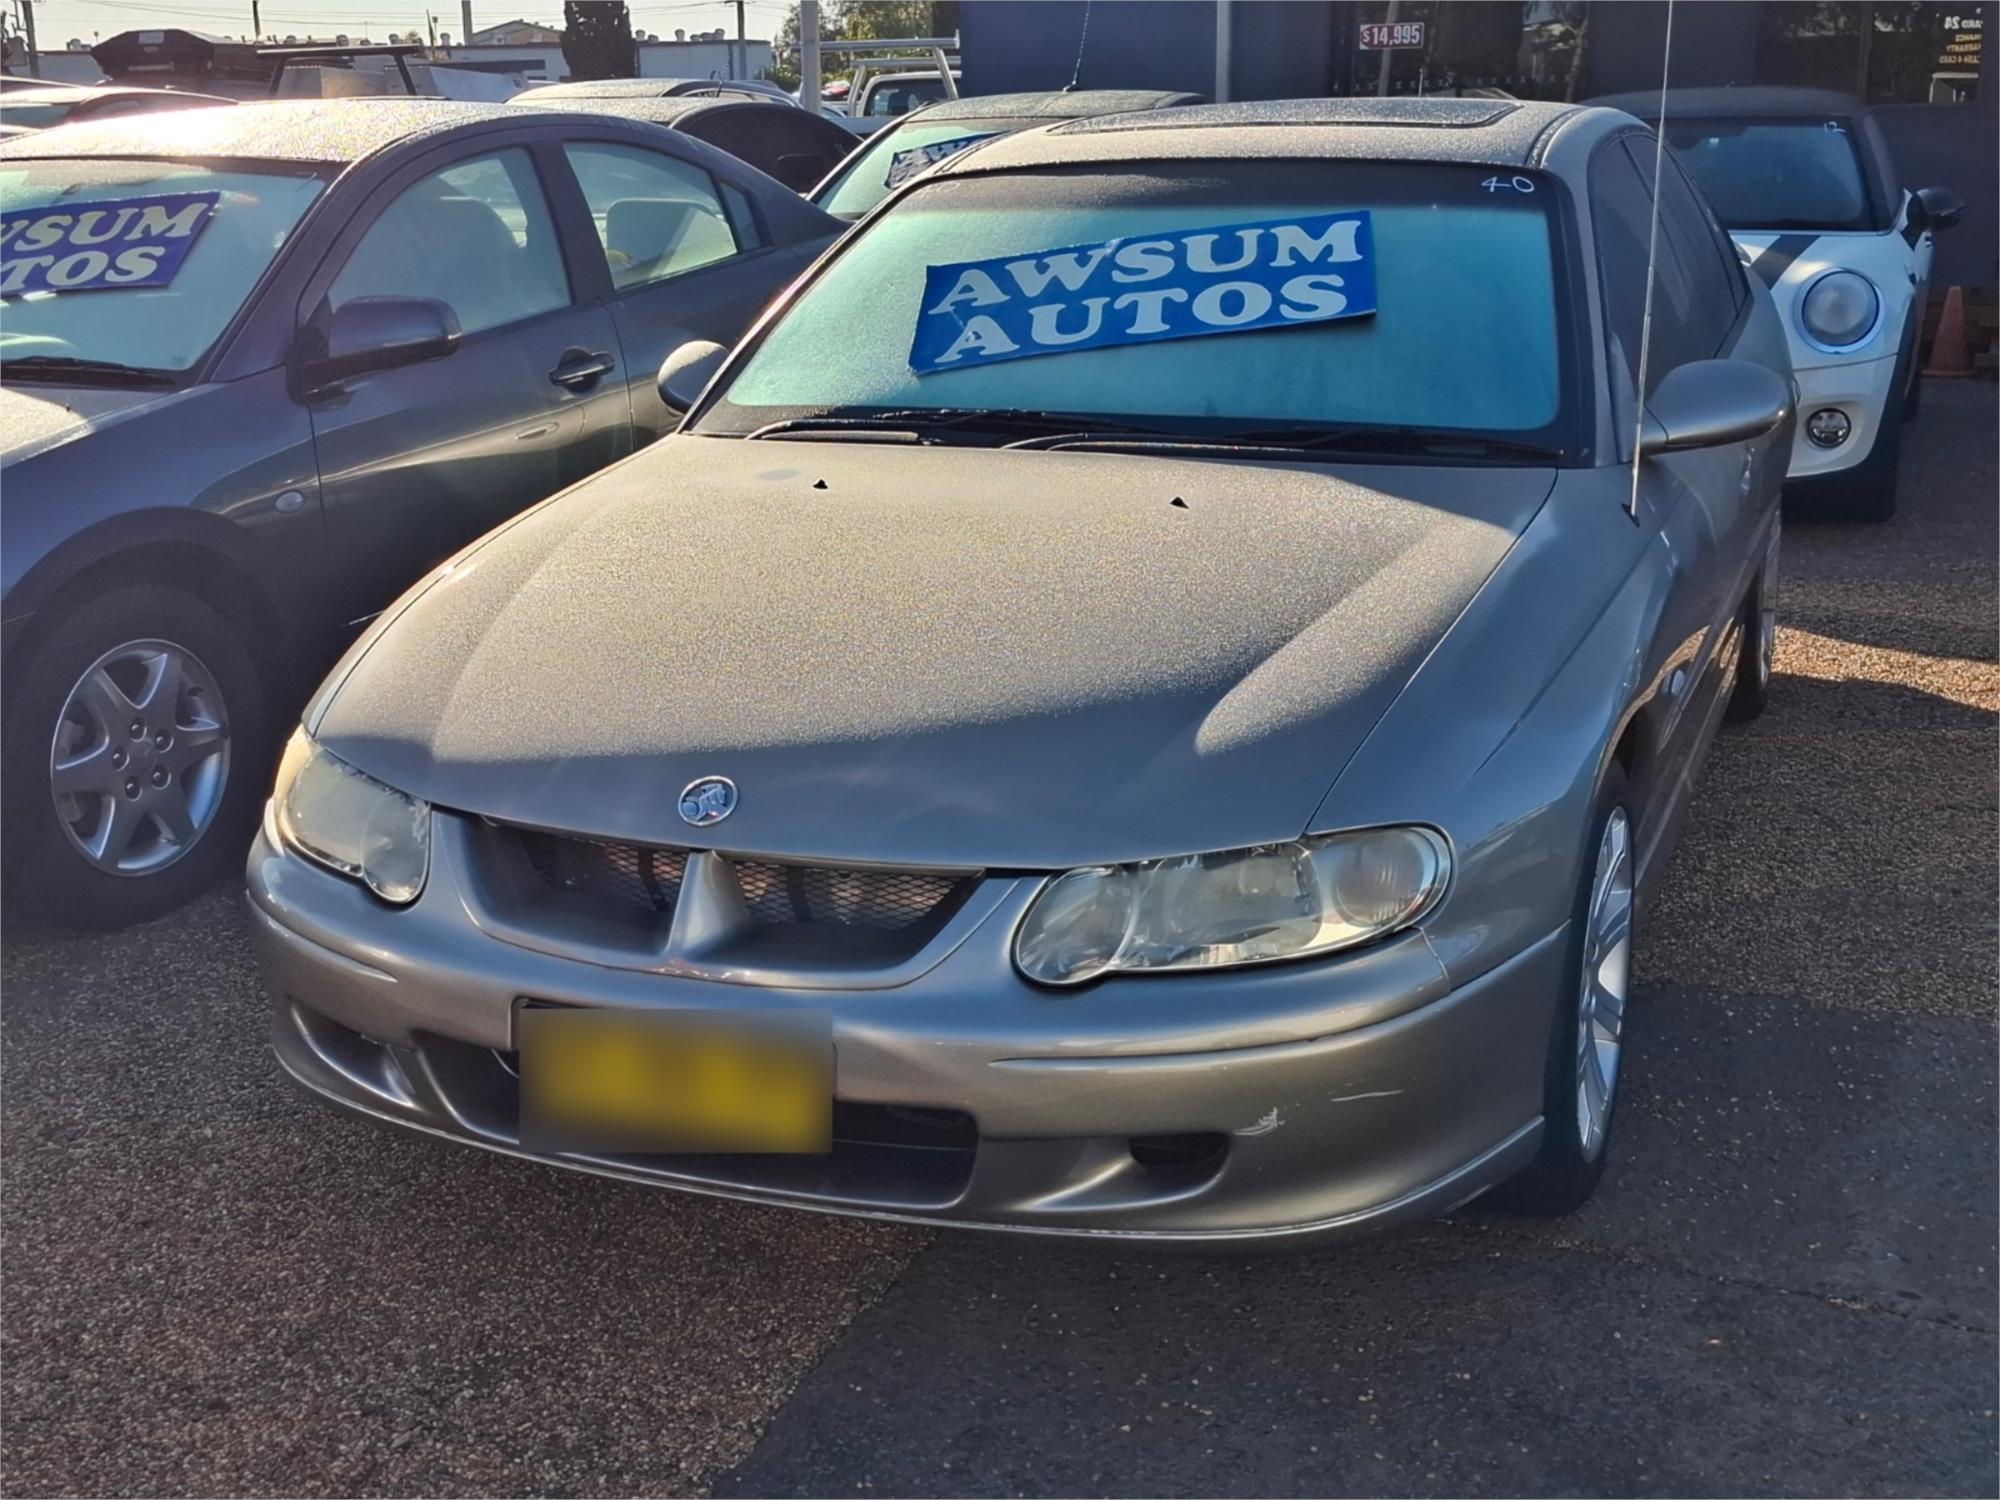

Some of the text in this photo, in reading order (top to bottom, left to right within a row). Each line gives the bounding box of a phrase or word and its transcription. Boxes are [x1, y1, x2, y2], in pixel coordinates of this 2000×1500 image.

[1362, 25, 1421, 46] $14,995
[1480, 176, 1535, 193] 40
[928, 220, 1363, 315] AWSUM
[934, 274, 1348, 363] AUTOS
